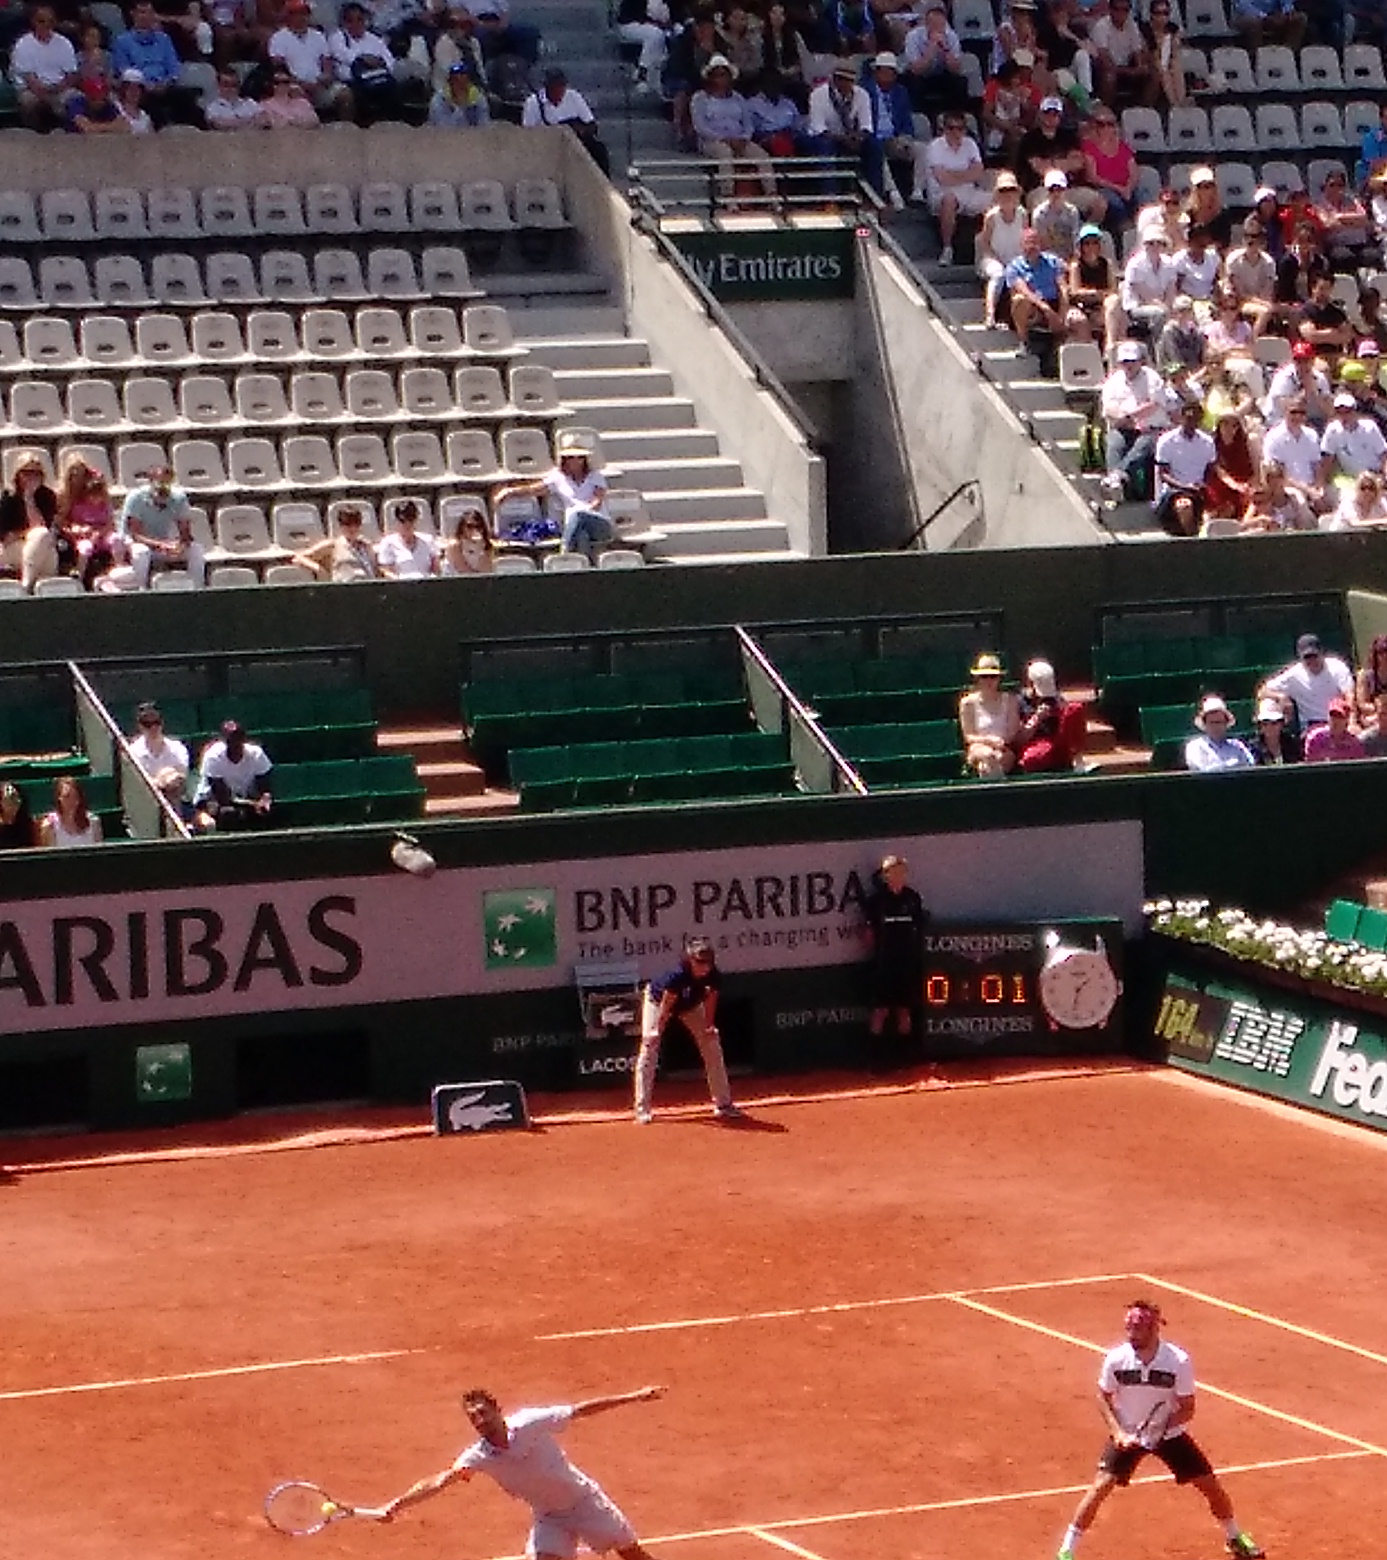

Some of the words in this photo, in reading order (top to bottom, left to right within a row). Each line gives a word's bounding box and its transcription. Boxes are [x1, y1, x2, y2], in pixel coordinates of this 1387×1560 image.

[719, 251, 841, 282] Emirates
[575, 887, 677, 933] BNP
[692, 870, 864, 924] PARIBA
[578, 941, 613, 958] The
[624, 934, 672, 956] bank
[737, 926, 829, 948] changing
[926, 1017, 1034, 1036] LONGINES
[1215, 1001, 1304, 1077] IBM
[578, 1056, 636, 1075] LACO
